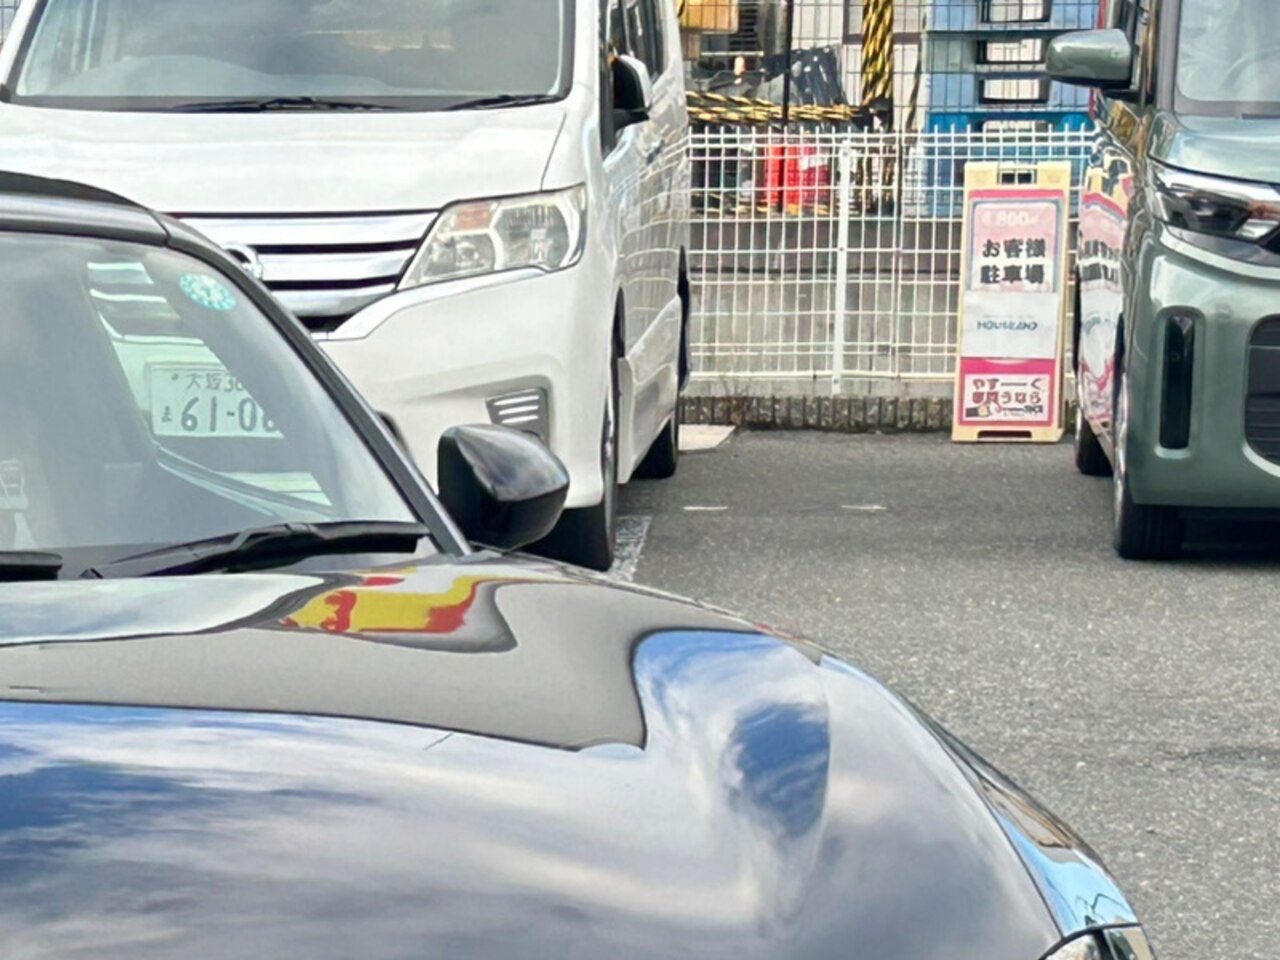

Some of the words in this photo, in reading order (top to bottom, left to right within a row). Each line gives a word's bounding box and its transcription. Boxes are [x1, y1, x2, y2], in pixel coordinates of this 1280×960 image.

[982, 238, 1046, 258] お客様
[980, 264, 1044, 284] 駐車場
